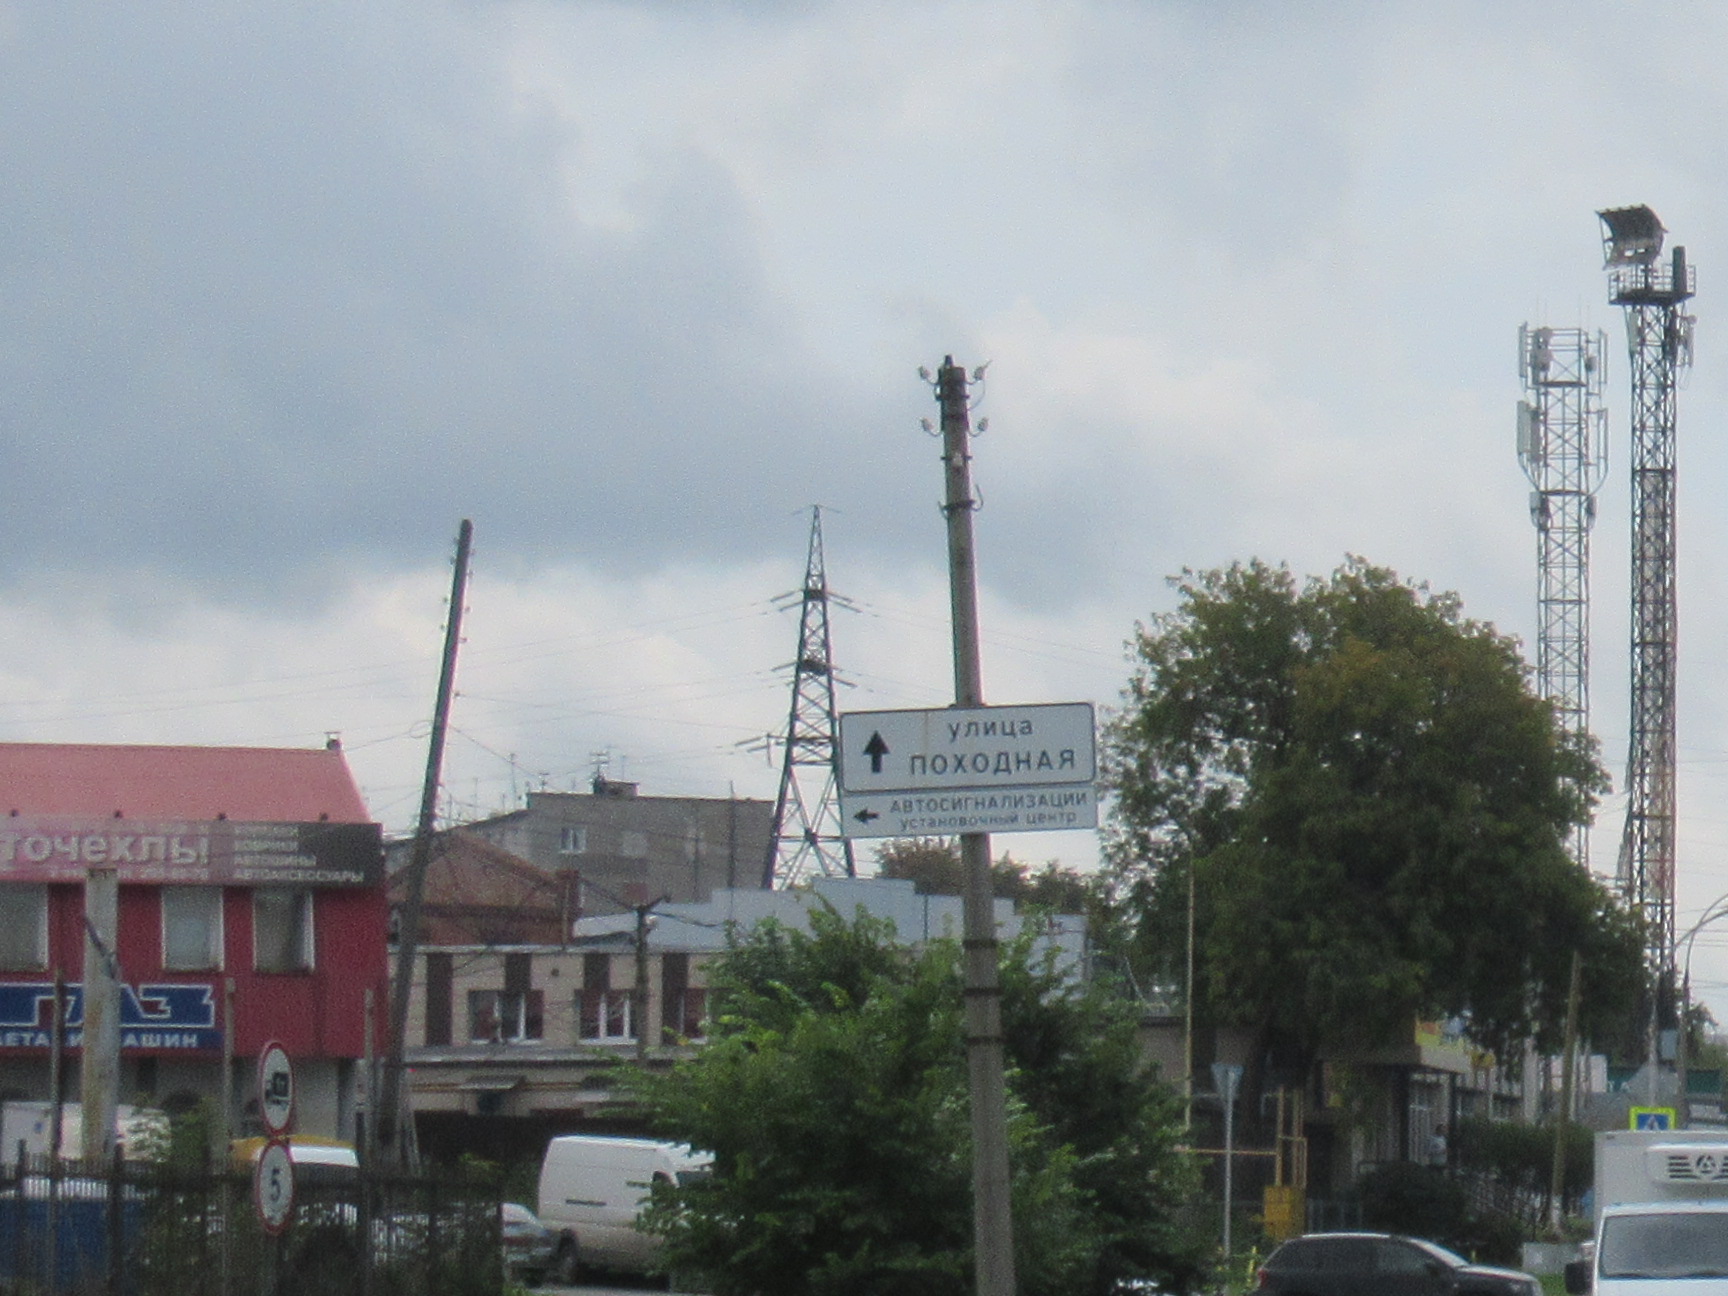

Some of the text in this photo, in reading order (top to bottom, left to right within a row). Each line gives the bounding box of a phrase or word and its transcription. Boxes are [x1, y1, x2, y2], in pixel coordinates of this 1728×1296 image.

[949, 718, 1034, 742] улица
[910, 749, 1076, 776] ПОХОДНАЯ
[890, 791, 1087, 814] АВТОСИГНАЛИЗАЦИИ
[1026, 811, 1077, 825] центр
[270, 1167, 282, 1203] 5
